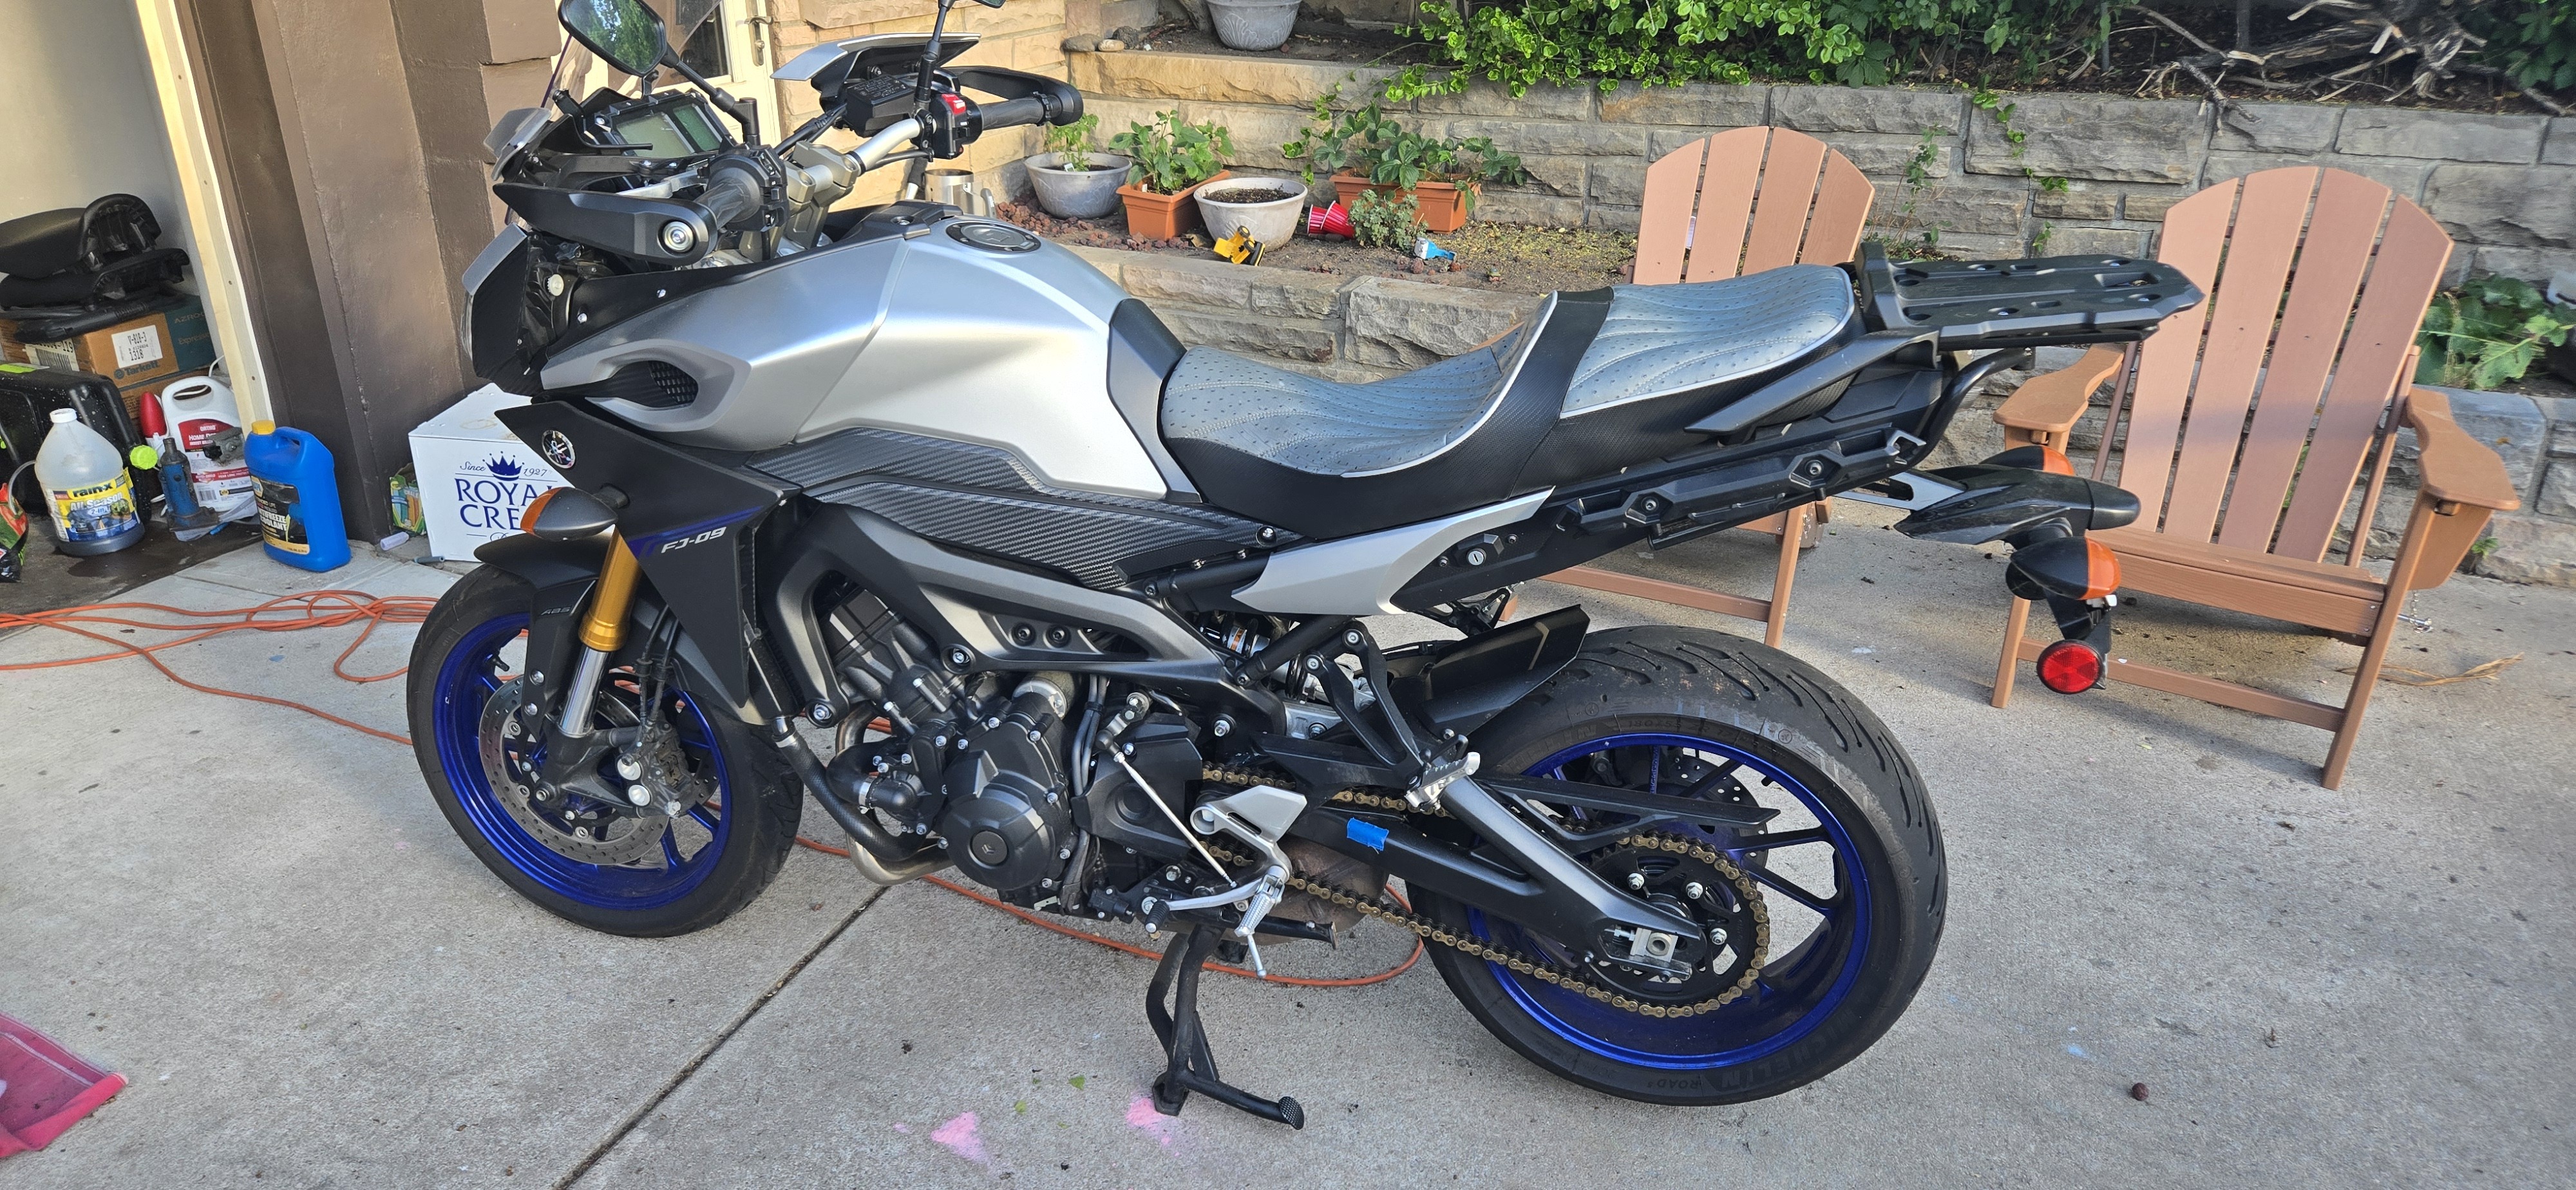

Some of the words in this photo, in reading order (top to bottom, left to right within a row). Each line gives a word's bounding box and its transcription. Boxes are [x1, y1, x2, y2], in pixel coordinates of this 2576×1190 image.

[129, 348, 144, 361] 1318
[459, 461, 486, 471] Since
[523, 468, 547, 477] 1927
[454, 478, 553, 506] ROYA
[661, 526, 727, 553] FJ-09
